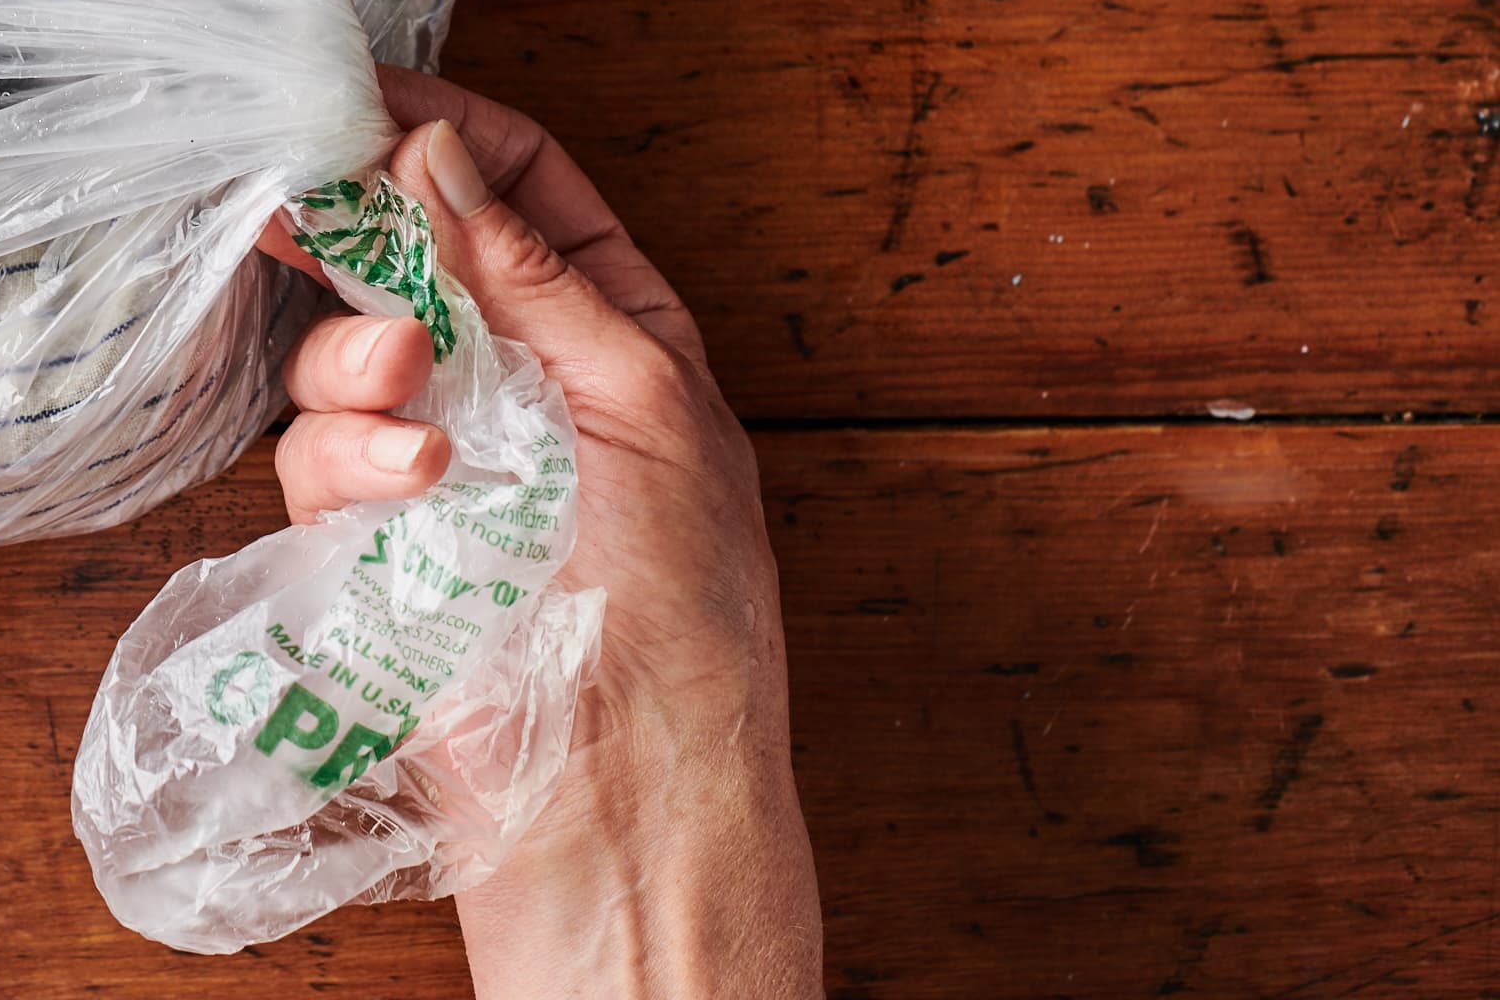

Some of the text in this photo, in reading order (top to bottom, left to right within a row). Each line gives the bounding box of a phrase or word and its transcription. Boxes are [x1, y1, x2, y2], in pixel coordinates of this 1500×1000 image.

[453, 506, 468, 529] is
[470, 521, 513, 552] not
[513, 539, 525, 557] a
[526, 538, 550, 565] toy.
[328, 660, 359, 691] IN
[402, 645, 455, 676] OTHERS
